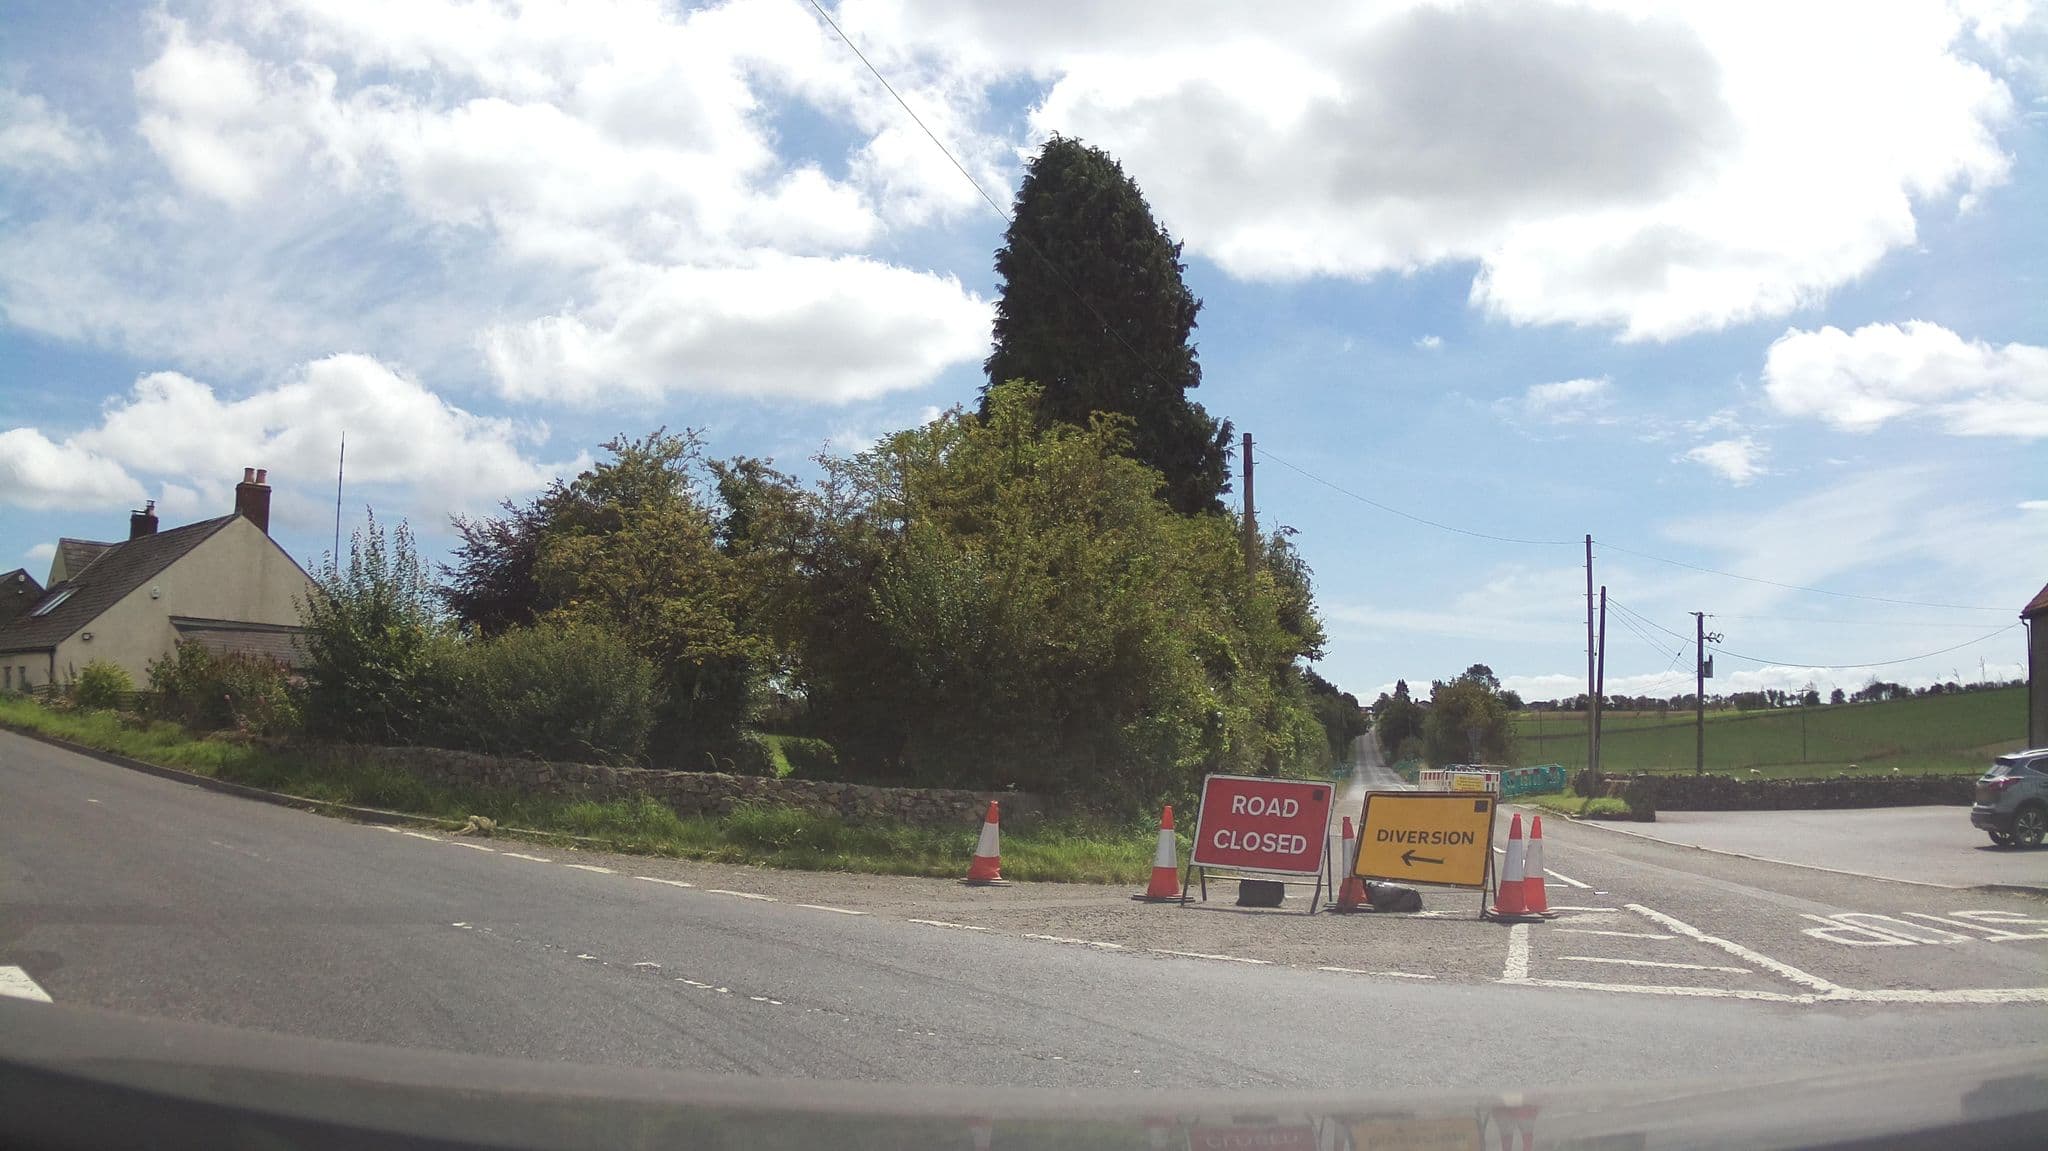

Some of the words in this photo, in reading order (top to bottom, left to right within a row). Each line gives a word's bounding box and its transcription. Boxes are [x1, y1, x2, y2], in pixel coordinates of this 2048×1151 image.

[1231, 795, 1299, 818] ROAD
[1213, 829, 1307, 855] CLOSED
[1376, 828, 1475, 845] DIVERSION
